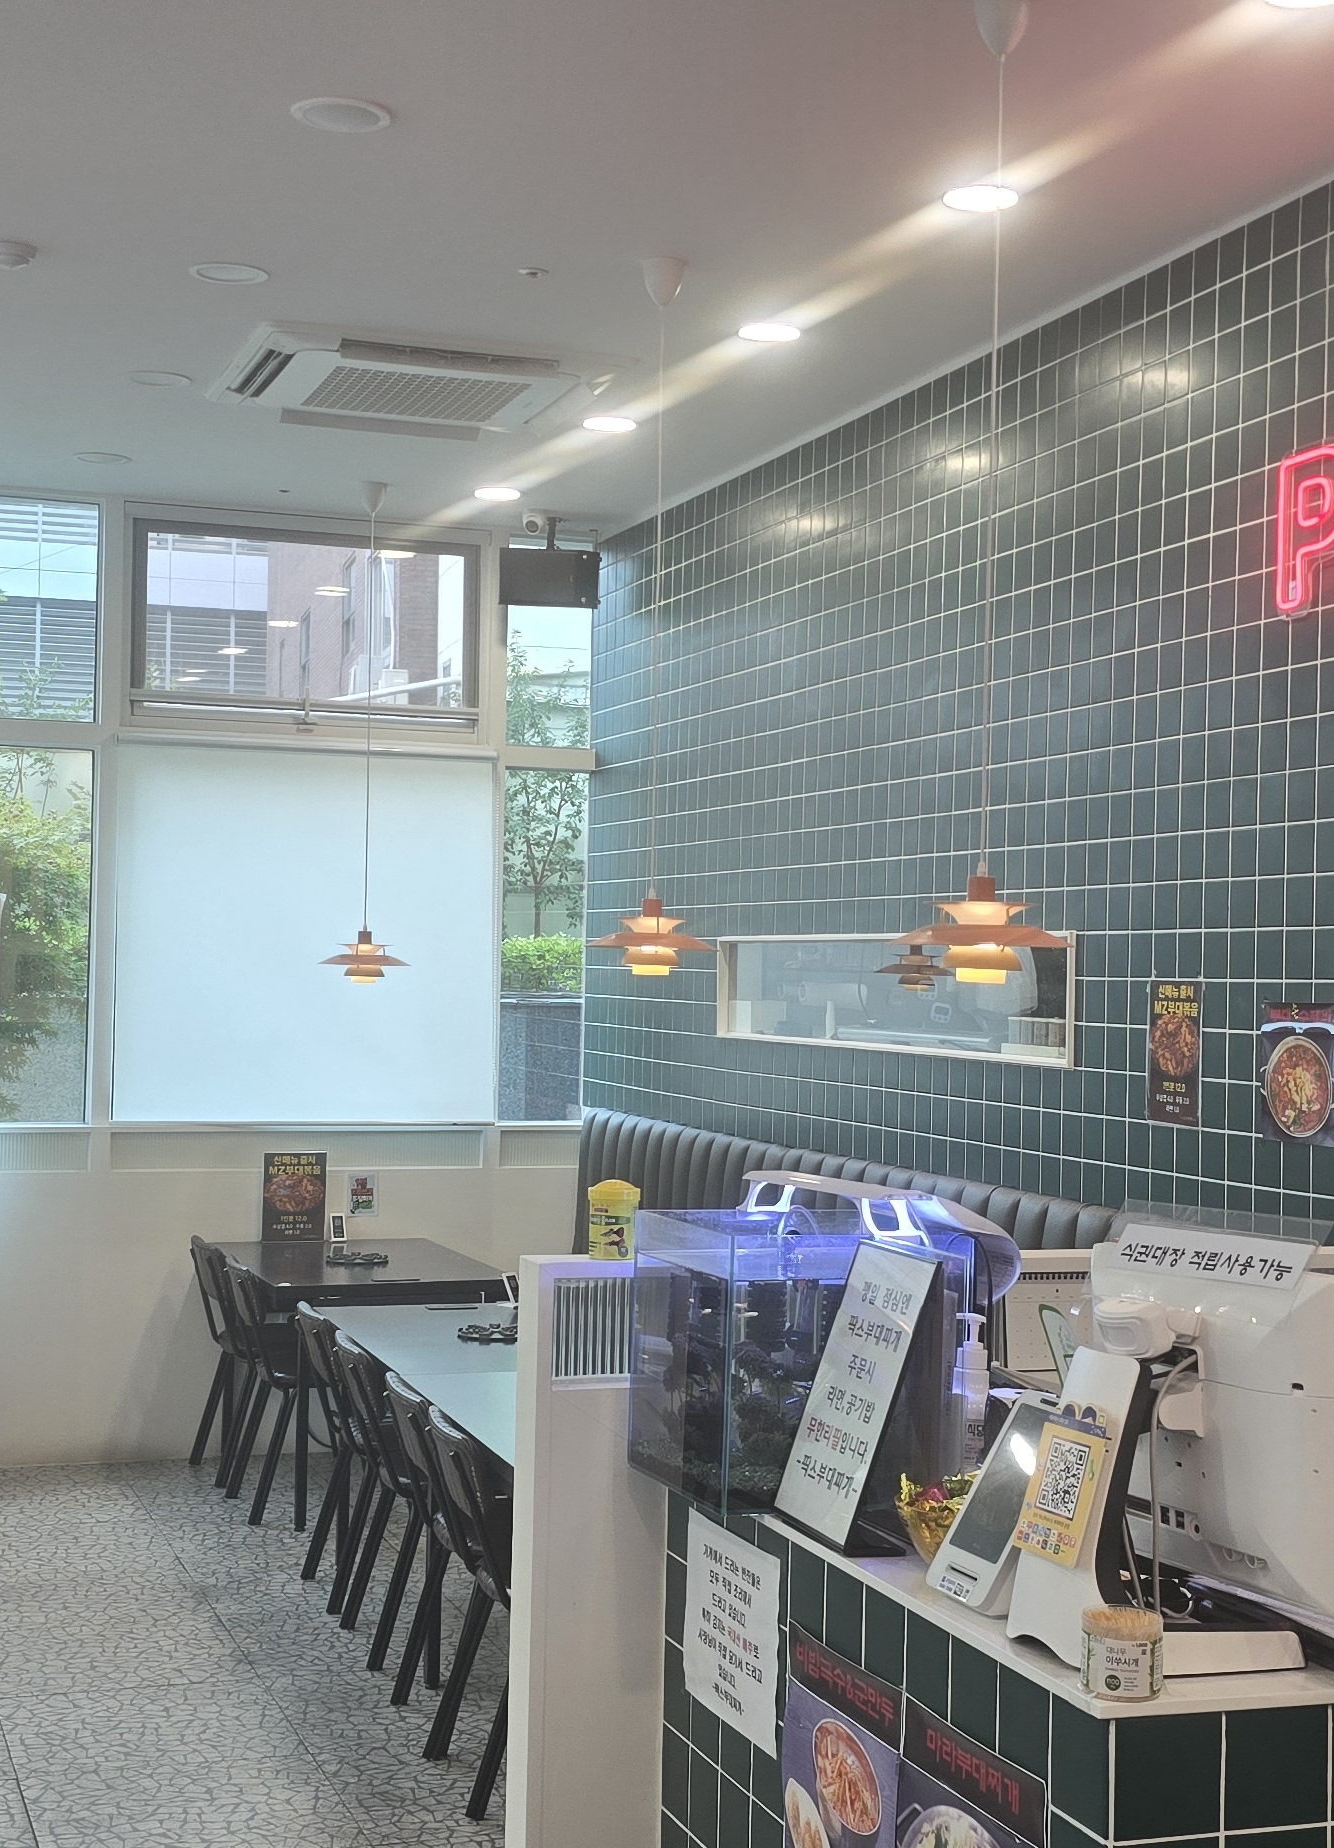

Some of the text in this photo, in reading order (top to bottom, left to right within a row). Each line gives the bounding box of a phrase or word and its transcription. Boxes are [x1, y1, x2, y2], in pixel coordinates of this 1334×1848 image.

[1154, 1000, 1199, 1017] MZ부대볶음
[1120, 1242, 1293, 1282] 식권대장 적립사용가능
[861, 1280, 913, 1316] 평일 점심엔
[847, 1353, 877, 1385] 주문시
[1105, 1645, 1127, 1656] 대나무
[1105, 1655, 1140, 1668] 이쑤시개
